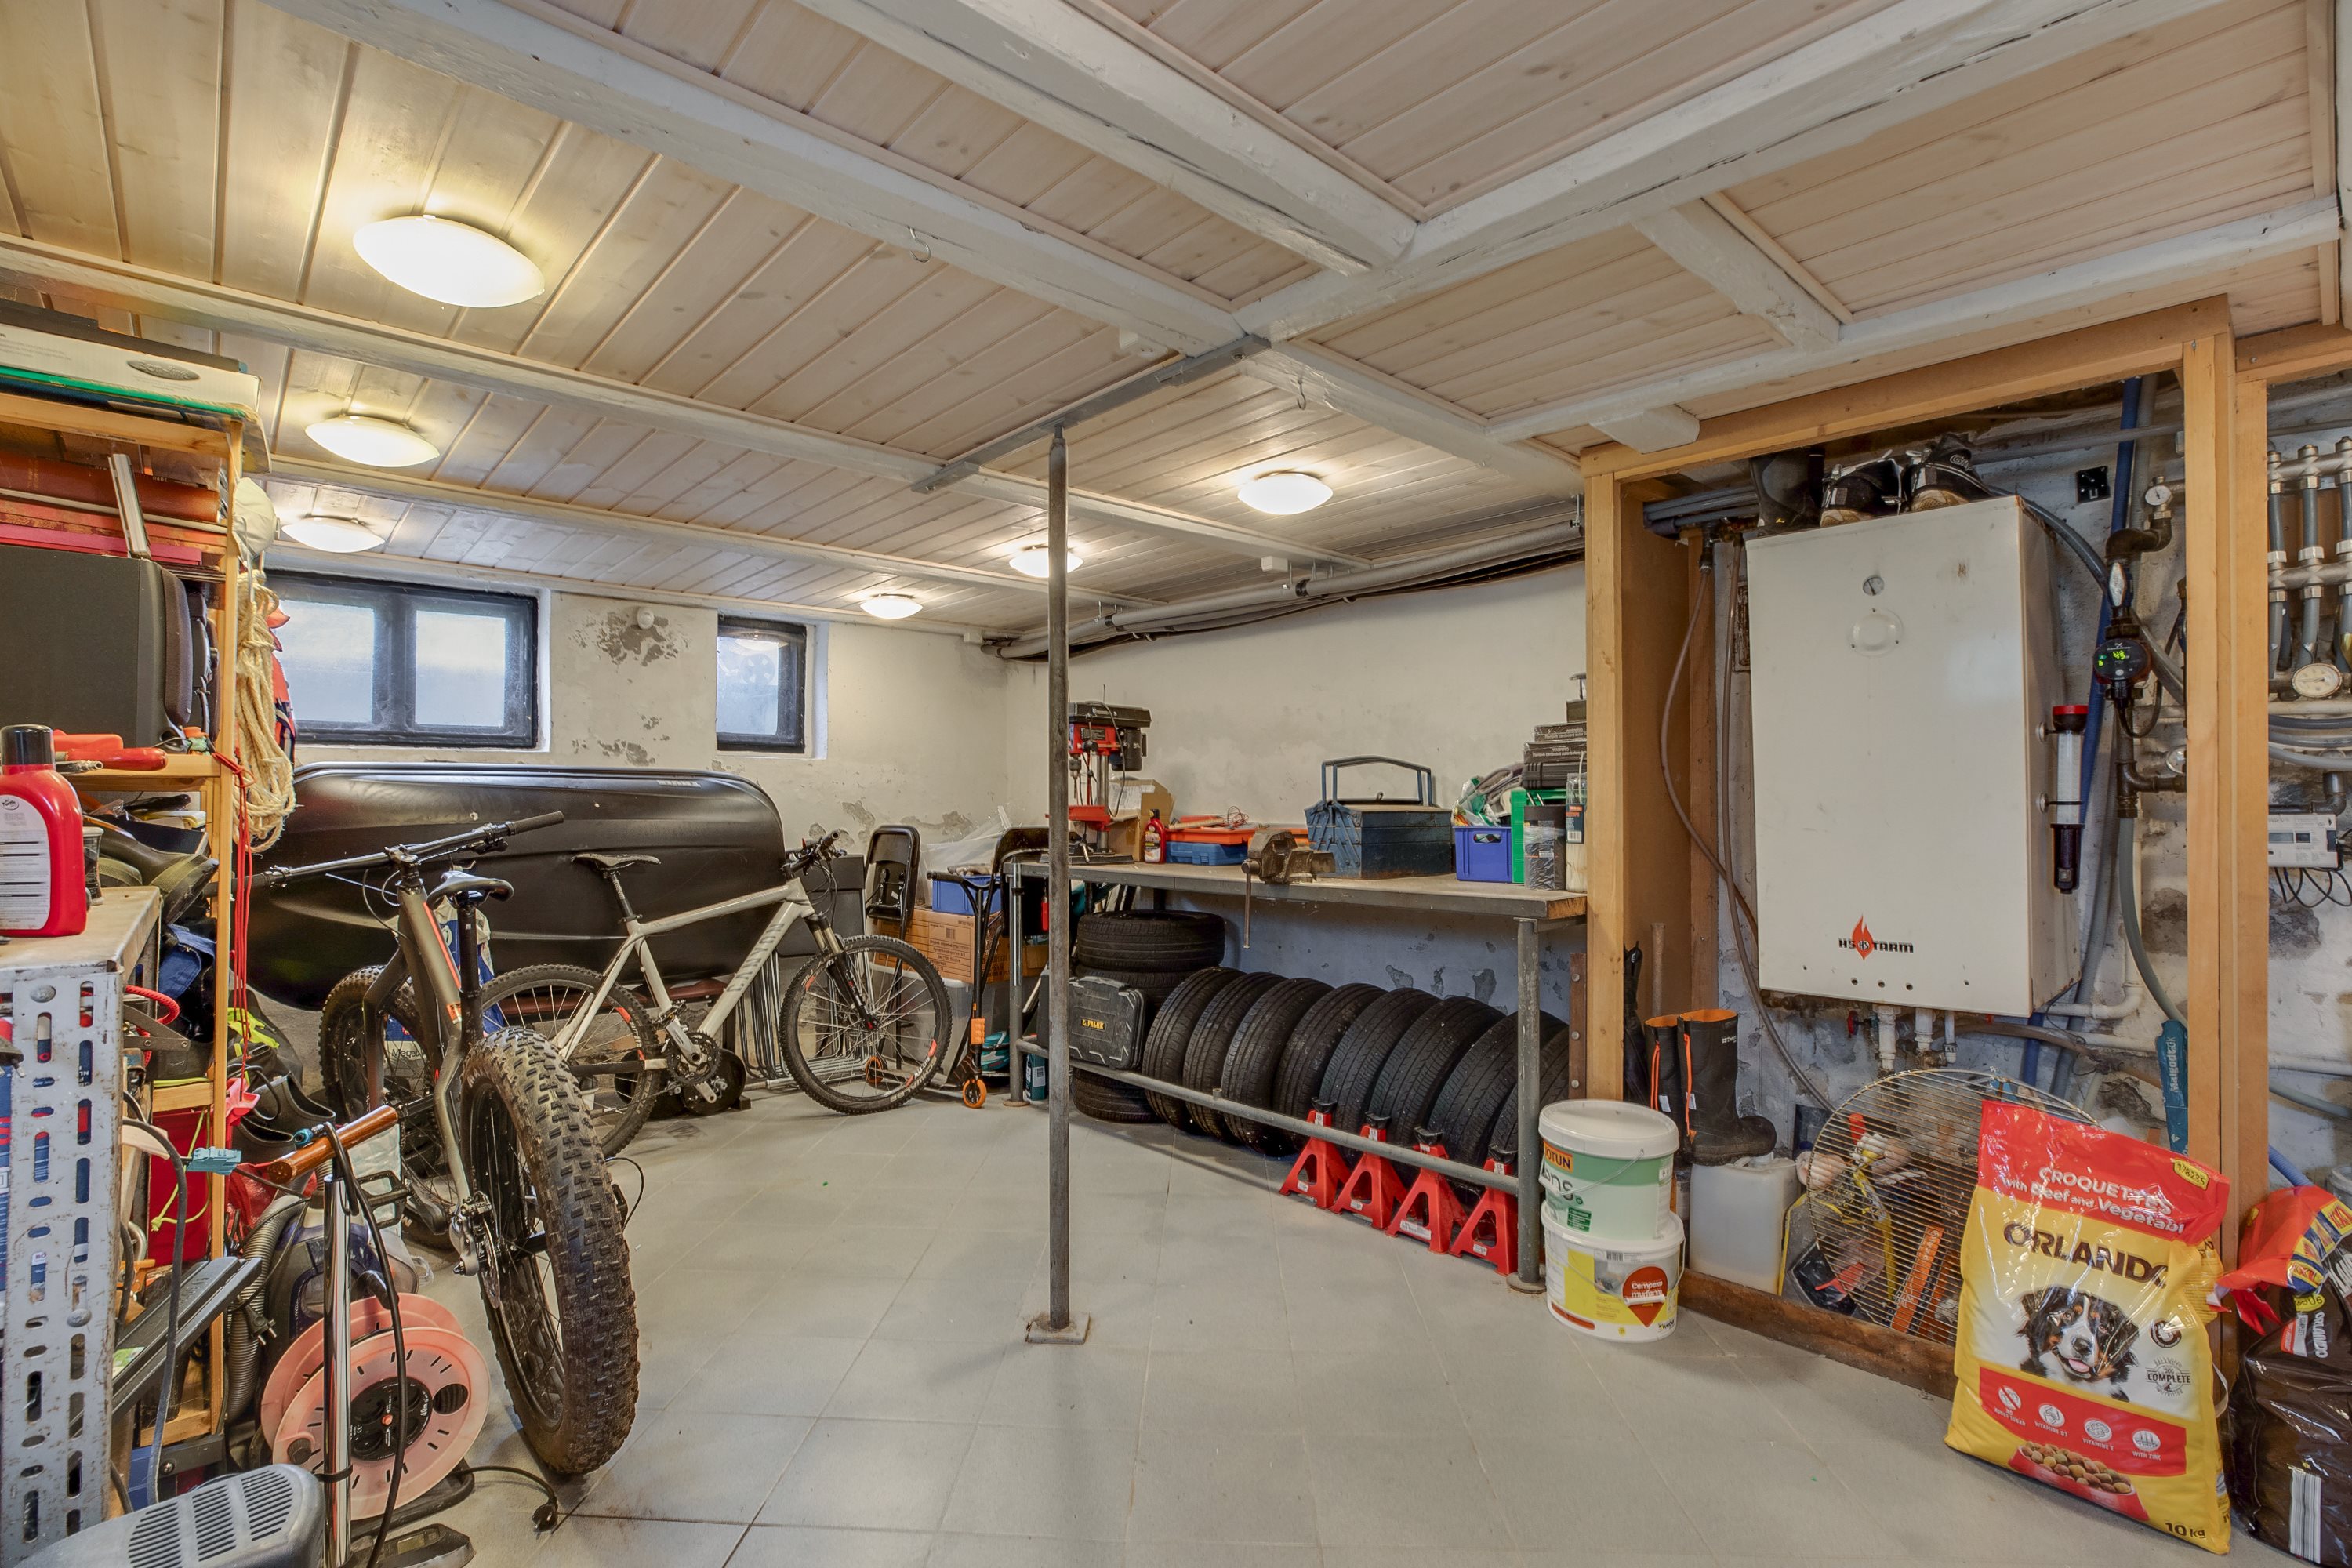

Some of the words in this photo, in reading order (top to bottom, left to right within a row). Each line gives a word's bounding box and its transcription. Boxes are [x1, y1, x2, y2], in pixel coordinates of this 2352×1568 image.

[726, 923, 785, 993] CANYON
[1545, 1148, 1571, 1170] OTUN
[2002, 1176, 2028, 1193] with
[2030, 1181, 2071, 1203] Beef
[2070, 1196, 2095, 1210] and
[2038, 1166, 2173, 1216] CROQUETTES
[2312, 1312, 2329, 1359] ORLANDO
[2147, 1372, 2191, 1384] COMPLETE
[2132, 1450, 2148, 1460] WITH
[2164, 1522, 2187, 1537] 10
[2189, 1527, 2206, 1539] kg
